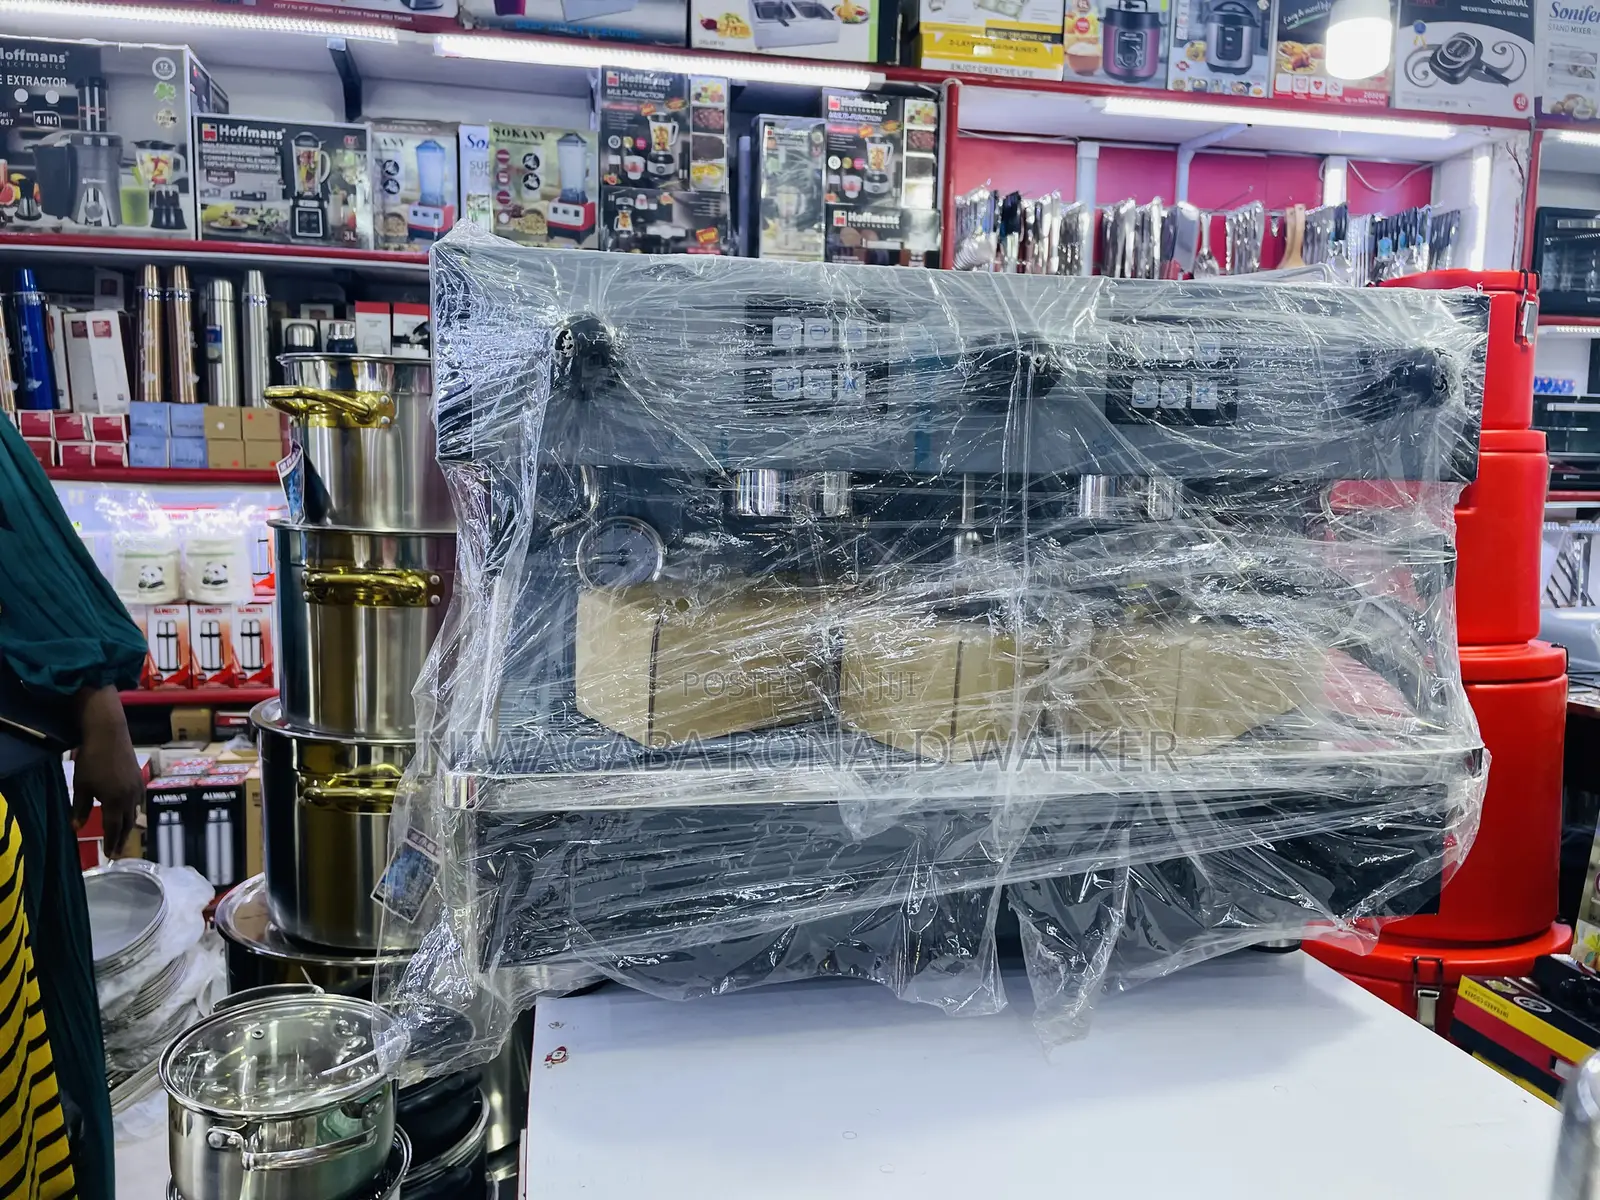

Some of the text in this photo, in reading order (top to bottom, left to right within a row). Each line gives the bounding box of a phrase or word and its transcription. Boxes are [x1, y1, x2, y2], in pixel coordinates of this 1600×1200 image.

[1548, 23, 1592, 35] STAND MIXER
[7, 75, 67, 88] EXTRACTOR
[219, 124, 283, 140] Hoffmans
[493, 126, 545, 140] SOKANY
[219, 138, 283, 146] ELECTRONICS
[847, 211, 900, 225] Hoffmans
[152, 793, 188, 803] ALWAYS
[202, 790, 237, 801] ALWAYS
